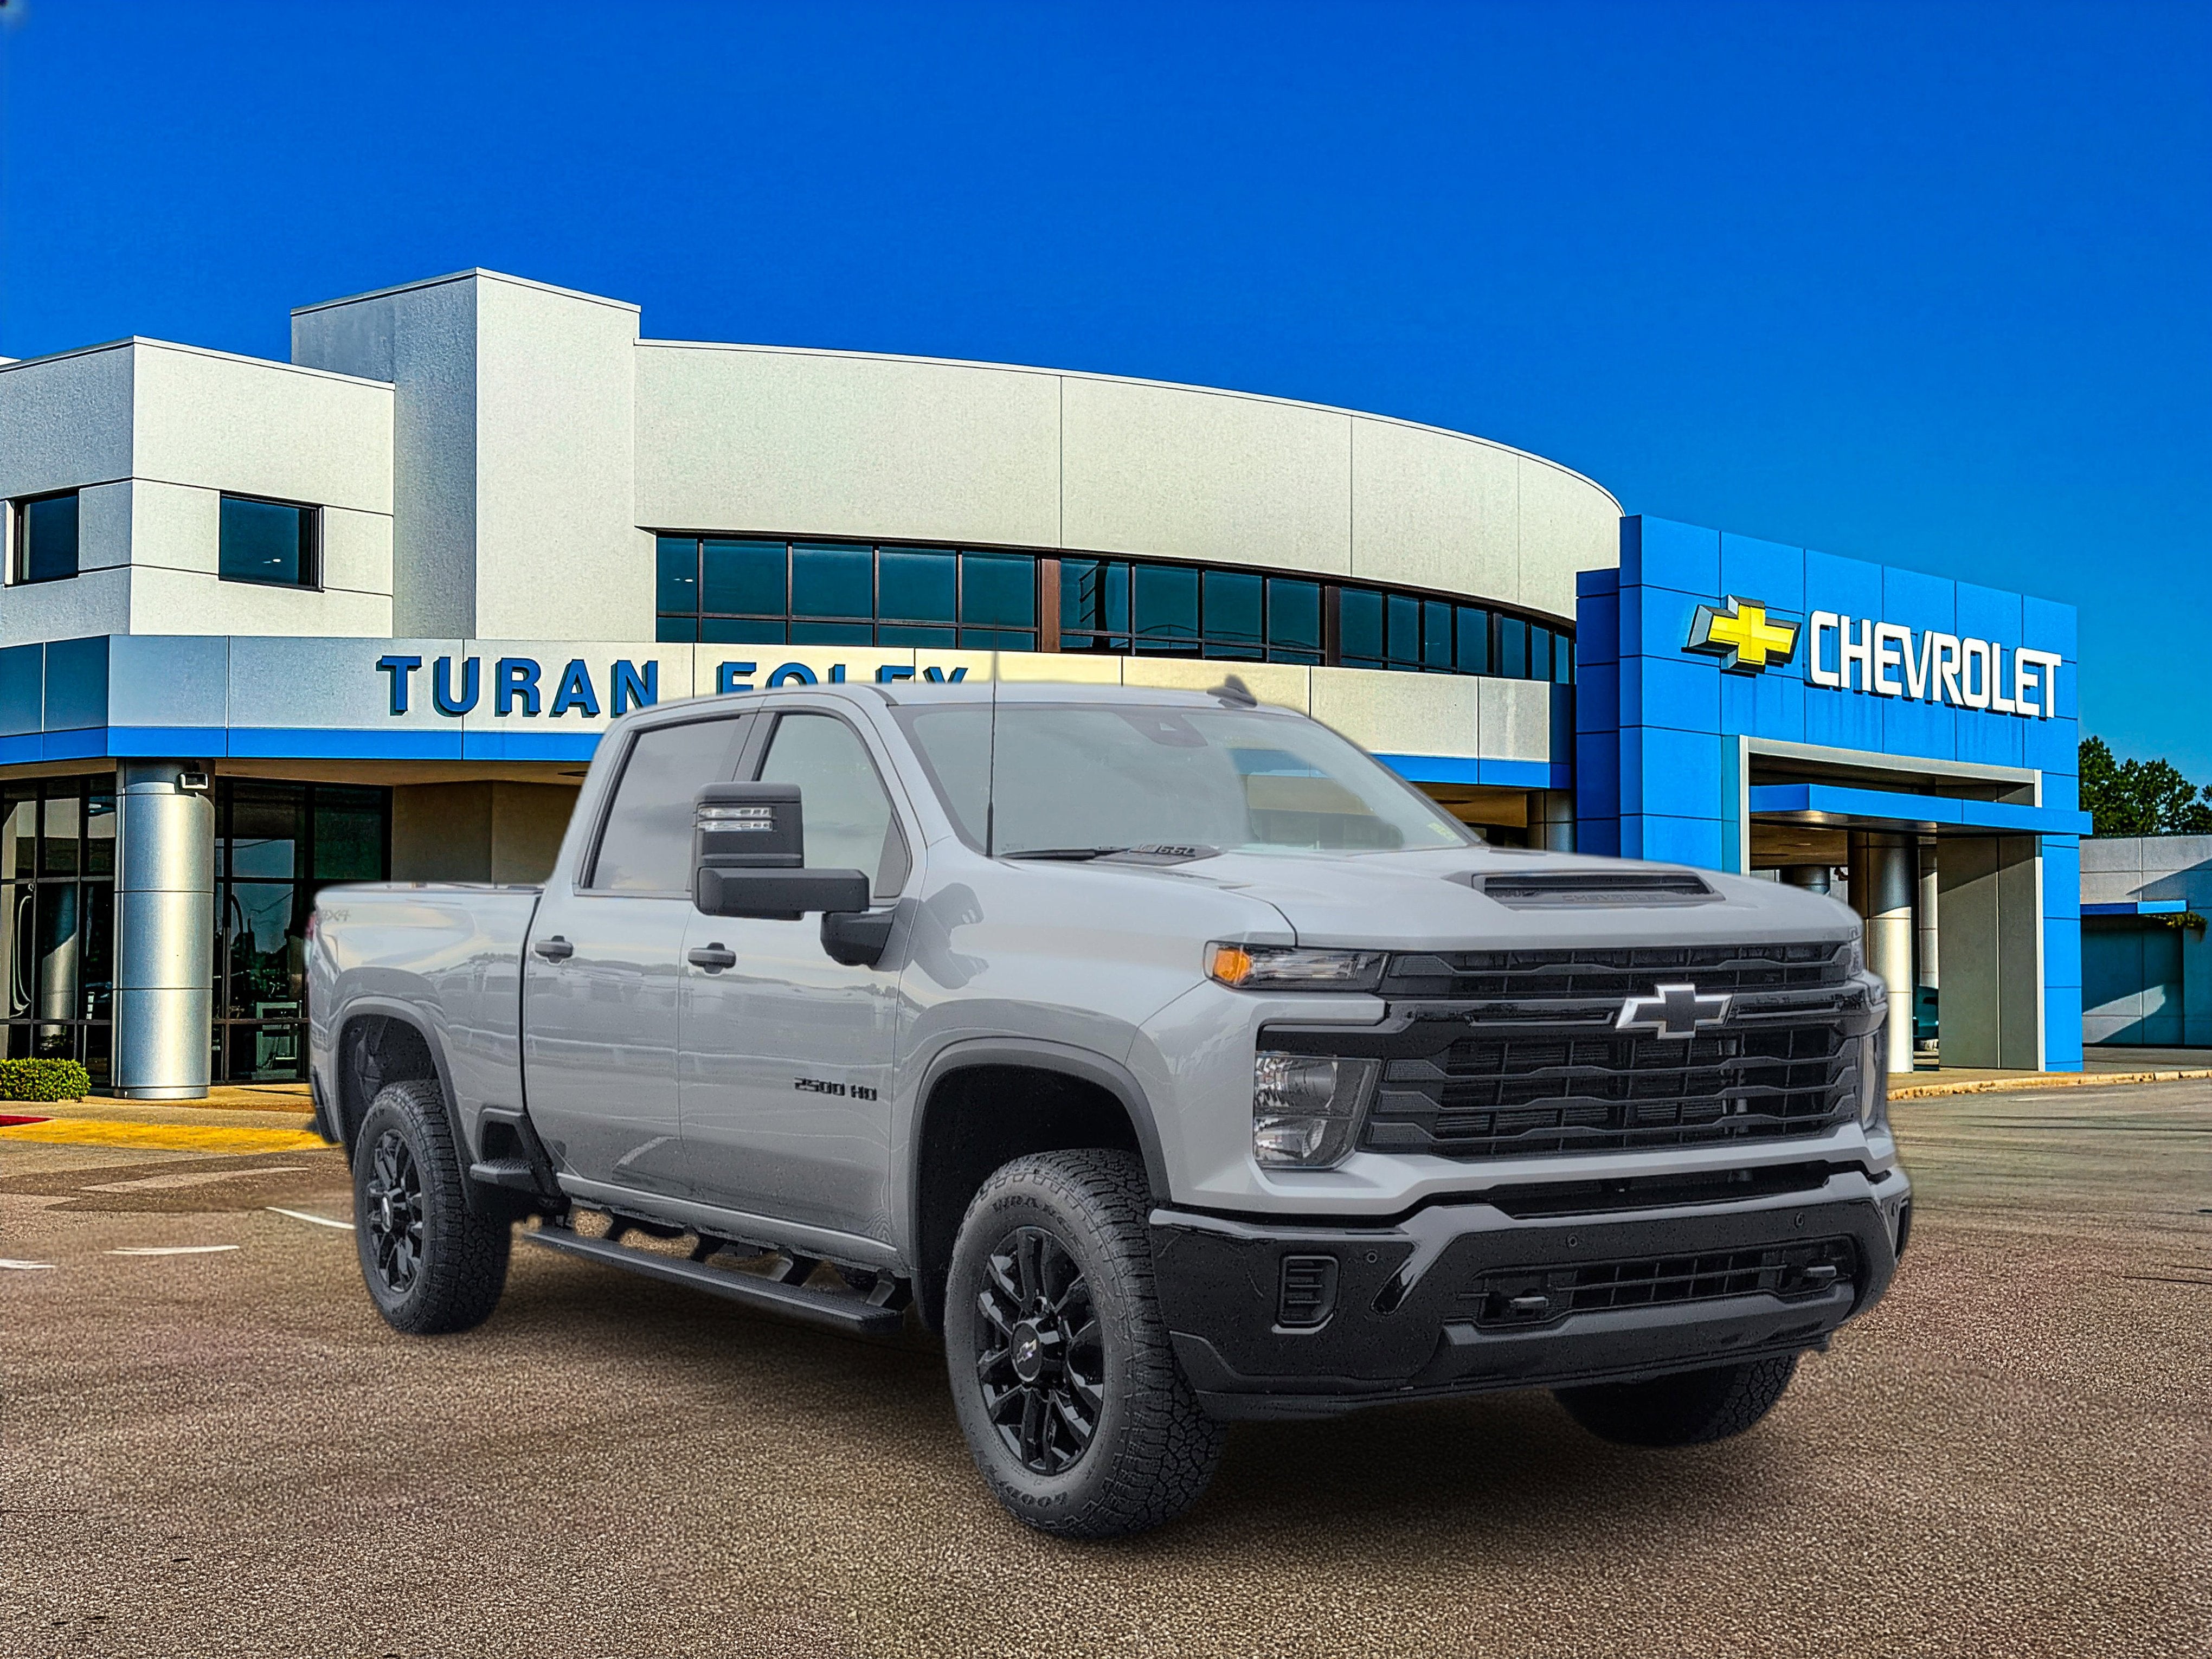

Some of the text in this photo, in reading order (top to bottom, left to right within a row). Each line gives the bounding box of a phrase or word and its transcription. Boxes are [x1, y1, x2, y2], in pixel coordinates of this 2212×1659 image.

[376, 655, 658, 718] TURAN
[1808, 609, 2062, 719] CHEVROLET
[794, 1077, 877, 1101] 2500 HD
